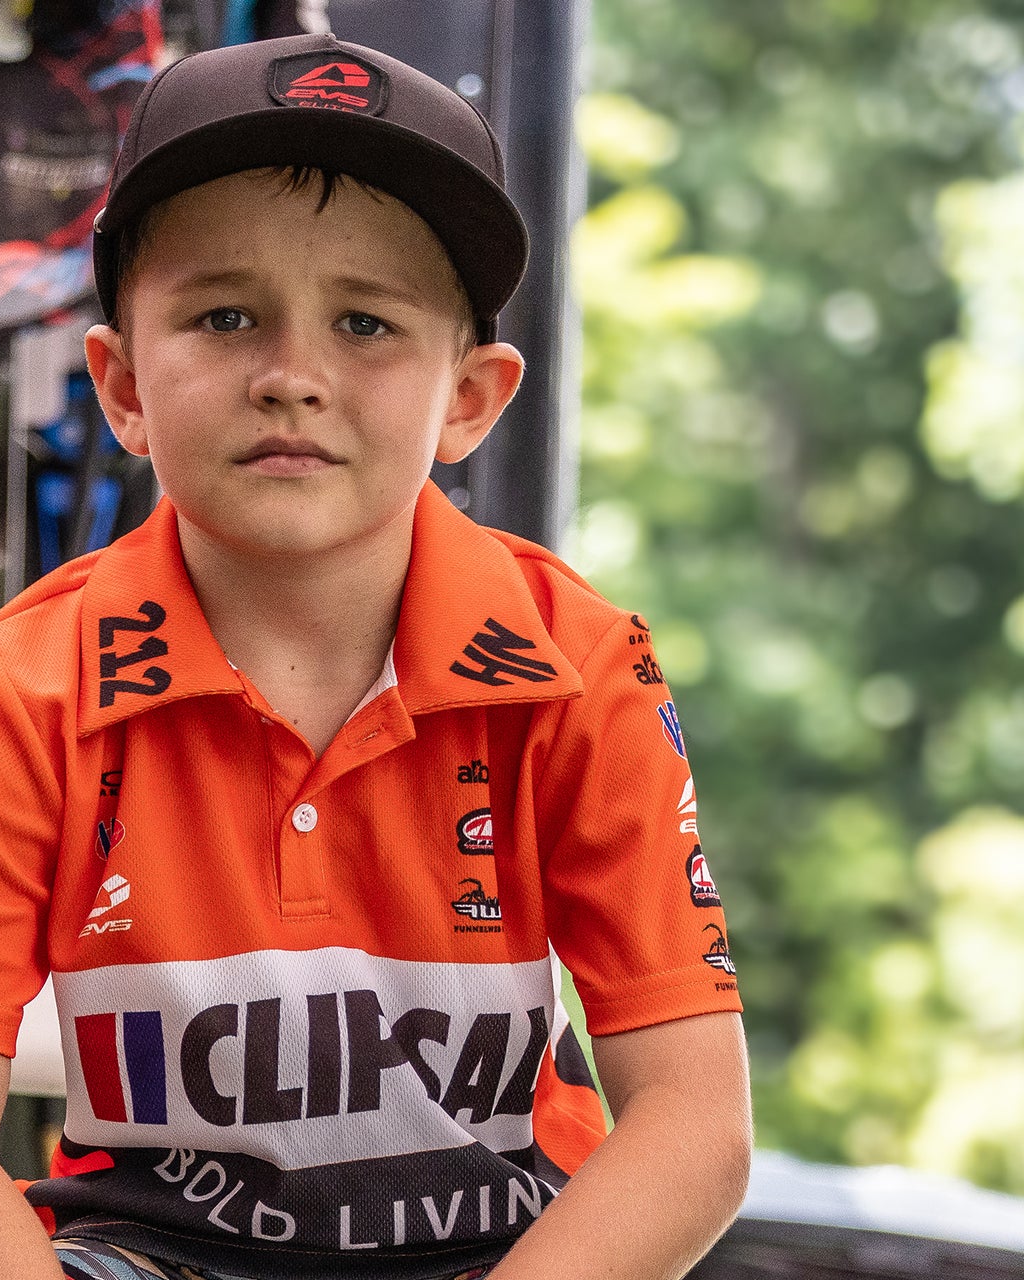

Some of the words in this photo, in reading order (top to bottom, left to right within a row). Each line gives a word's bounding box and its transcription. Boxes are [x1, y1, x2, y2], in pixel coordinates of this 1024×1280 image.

[99, 600, 172, 708] 212
[153, 1145, 298, 1243] BOLD
[340, 1169, 559, 1250] LIVIN
